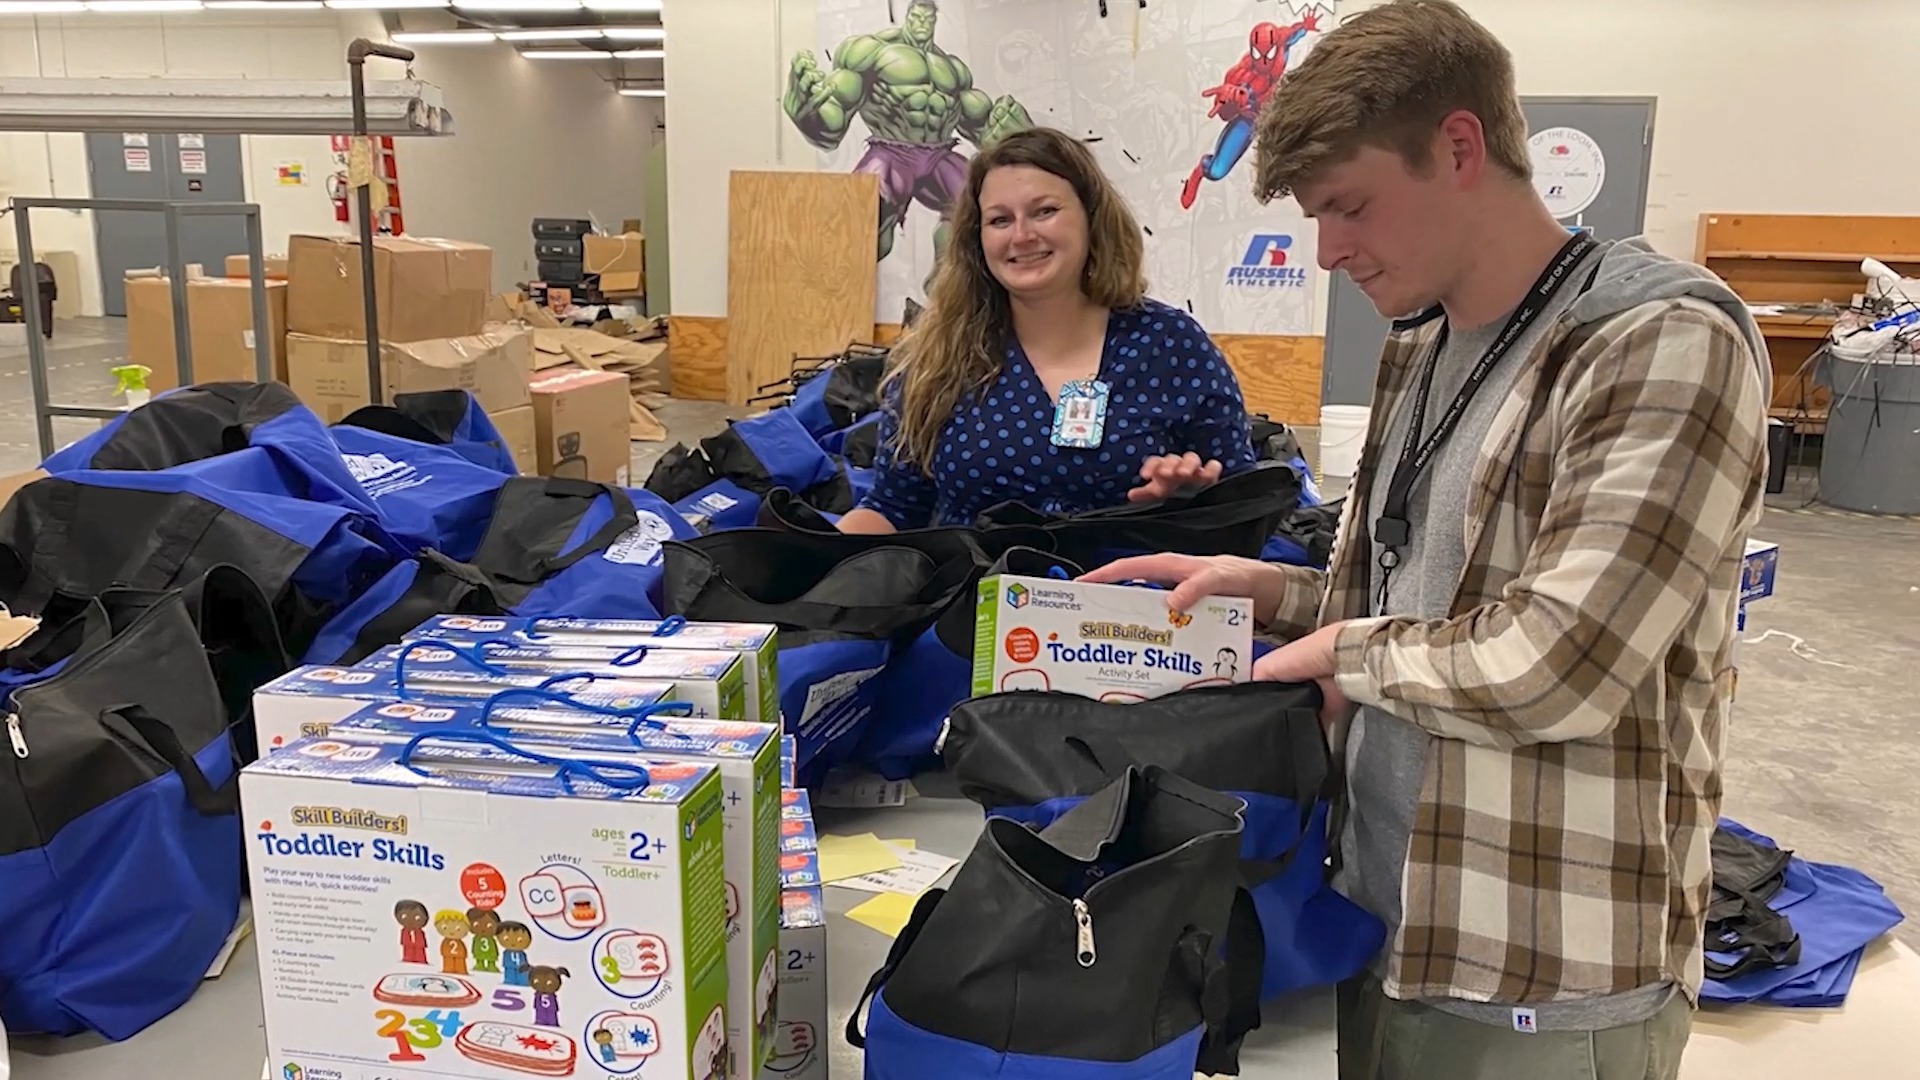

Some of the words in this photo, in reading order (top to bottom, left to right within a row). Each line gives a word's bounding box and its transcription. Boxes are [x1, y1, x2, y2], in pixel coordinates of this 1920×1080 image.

[1532, 135, 1544, 146] OF
[1228, 266, 1306, 279] RUSSELL
[1539, 274, 1555, 296] FRUIT
[1553, 263, 1564, 278] OF
[1560, 250, 1576, 268] THE
[1226, 279, 1305, 287] ATHLETIC
[1031, 587, 1075, 601] Learning
[1031, 598, 1081, 610] Resources
[1228, 609, 1248, 626] 2+
[1081, 624, 1110, 638] Skill
[1112, 626, 1172, 644] Builders!
[1048, 642, 1137, 666] Toddler
[1144, 648, 1202, 676] Skills
[1098, 667, 1132, 680] Activity
[1135, 669, 1150, 680] Set
[416, 746, 480, 758] Skills
[294, 808, 330, 824] Skill
[332, 811, 406, 832] Builders!
[592, 828, 626, 842] ages
[258, 833, 364, 858] Toddler
[373, 839, 445, 870] Skills
[630, 832, 666, 860] 2+
[540, 854, 582, 865] Letters!
[602, 865, 660, 880] Toddler+
[320, 881, 340, 889] quick
[478, 877, 488, 890] 5
[466, 890, 504, 901] Counting
[449, 940, 458, 954] 2
[480, 938, 490, 952] 3
[510, 951, 520, 966] 4
[788, 949, 816, 970] 2+
[601, 956, 622, 984] 3
[491, 988, 526, 1010] 5
[541, 995, 550, 1008] 5
[630, 980, 673, 1011] Counting!
[375, 1009, 406, 1037] 2
[424, 1010, 464, 1038] 4
[408, 1018, 442, 1048] 3
[389, 1030, 426, 1062] 1
[304, 1066, 342, 1079] Learning
